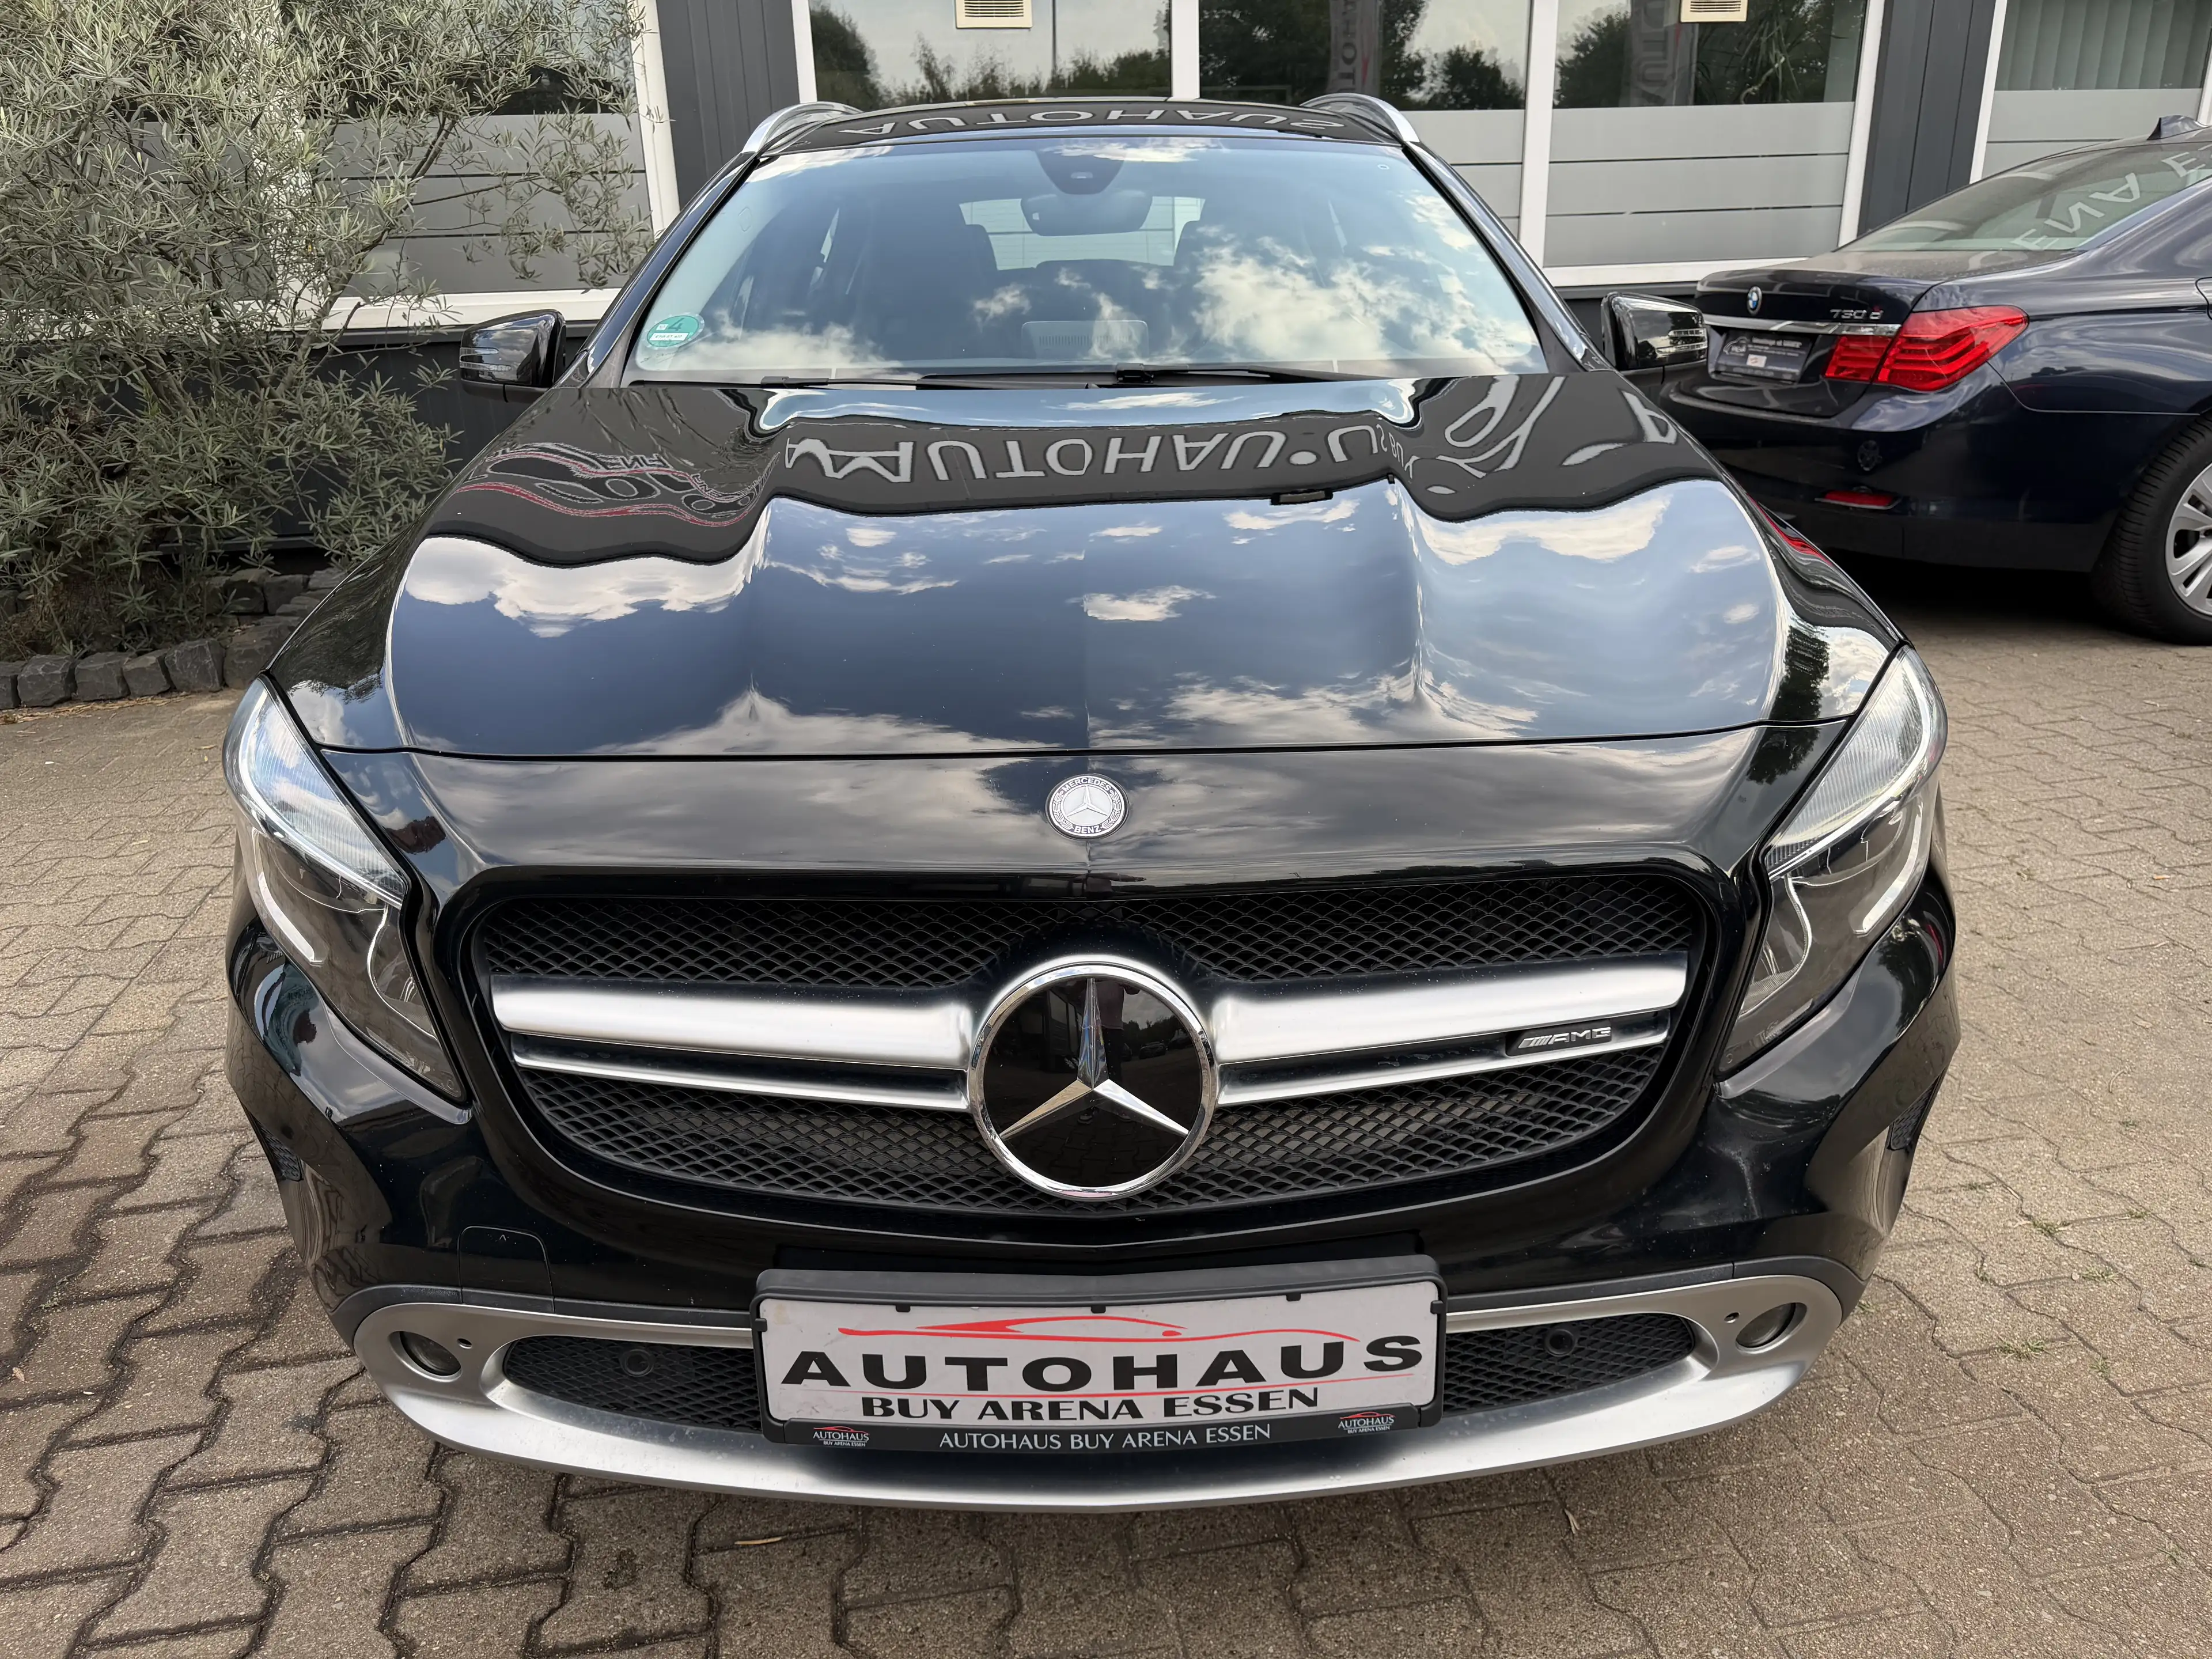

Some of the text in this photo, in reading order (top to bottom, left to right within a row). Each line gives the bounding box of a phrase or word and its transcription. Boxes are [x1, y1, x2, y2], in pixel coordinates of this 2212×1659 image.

[668, 317, 685, 331] 4
[1062, 778, 1112, 792] MERCEDES
[1074, 825, 1101, 834] BENZ
[1545, 1027, 1611, 1046] AMG
[781, 1336, 1422, 1392] AUTOHAUS
[862, 1387, 1319, 1421] BUY ARENA ESSEN
[1338, 1416, 1395, 1429] AUTOHAUS
[813, 1431, 870, 1441] AUTOHAUS
[940, 1423, 1270, 1449] AUTOHAUS BUY ARENA ESSEN
